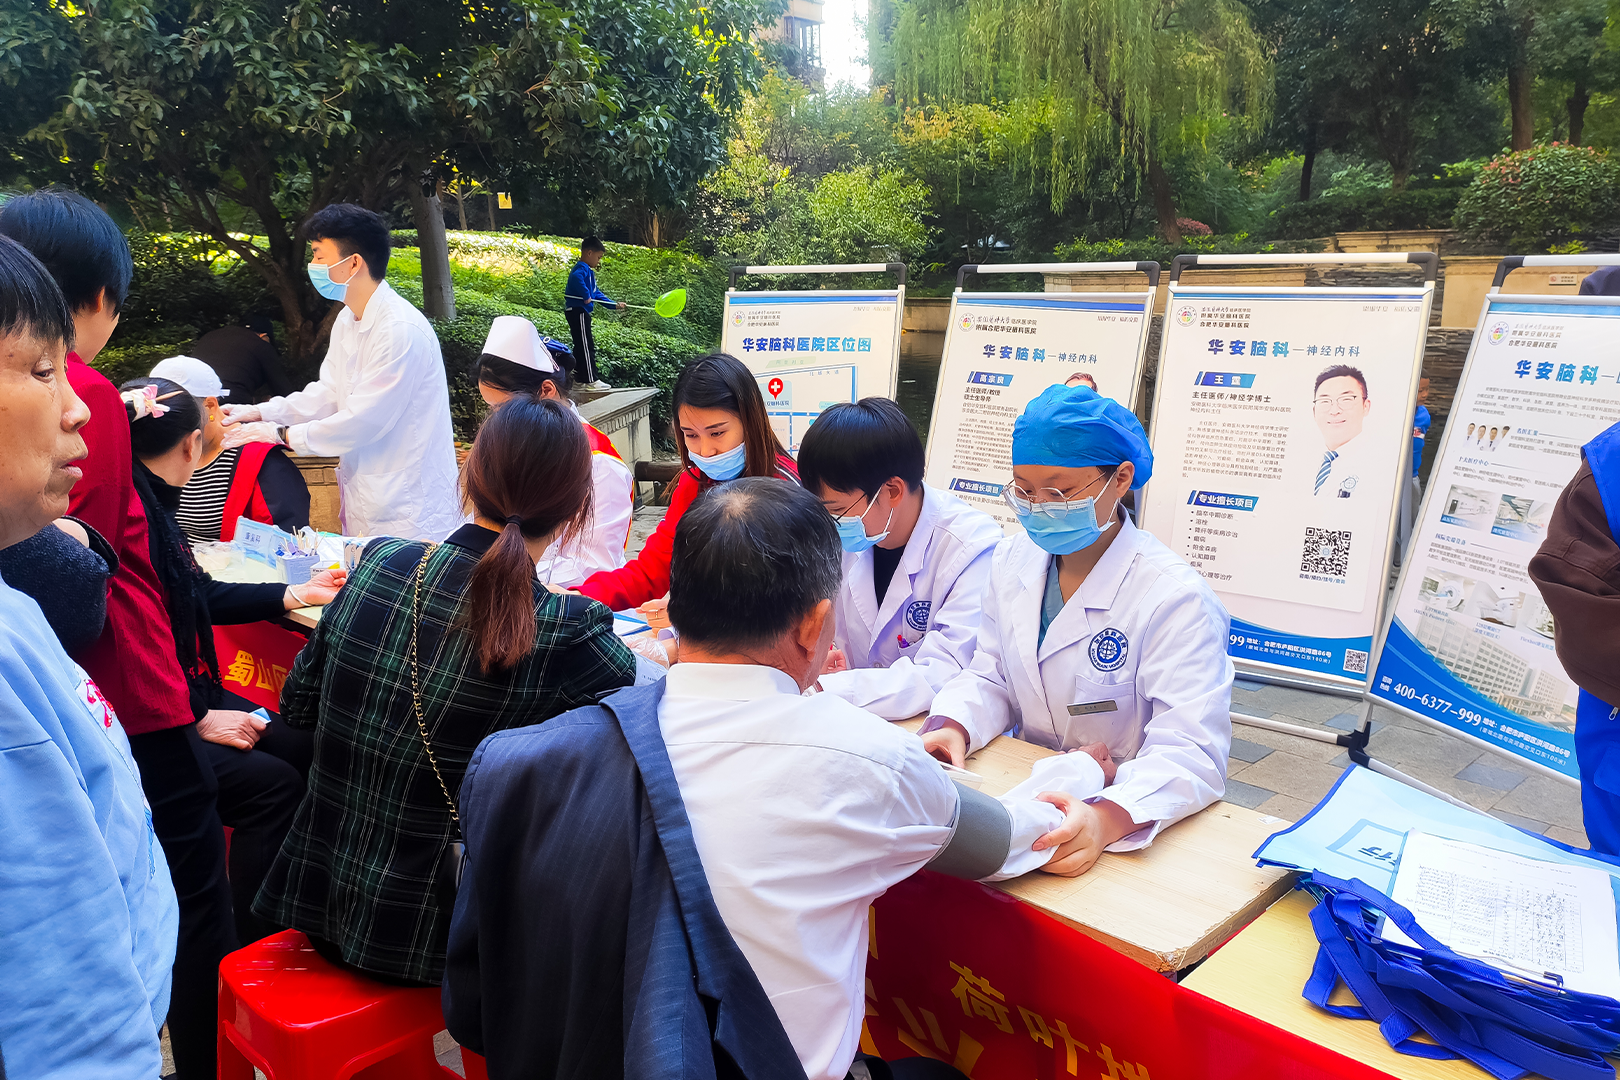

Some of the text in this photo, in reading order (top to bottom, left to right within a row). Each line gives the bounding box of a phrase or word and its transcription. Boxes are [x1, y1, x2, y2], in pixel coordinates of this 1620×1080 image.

[743, 337, 871, 352] 华安脑科医院区位图
[979, 374, 1004, 384] 高宗良
[1192, 391, 1272, 403] 主任医师/神经学博士
[959, 482, 999, 494] 专业擅长项目
[1199, 494, 1253, 508] 专业擅长项目
[1192, 544, 1217, 553] 帕金森病
[1191, 553, 1216, 561] 认知障碍
[1394, 682, 1481, 727] 400-6377-999
